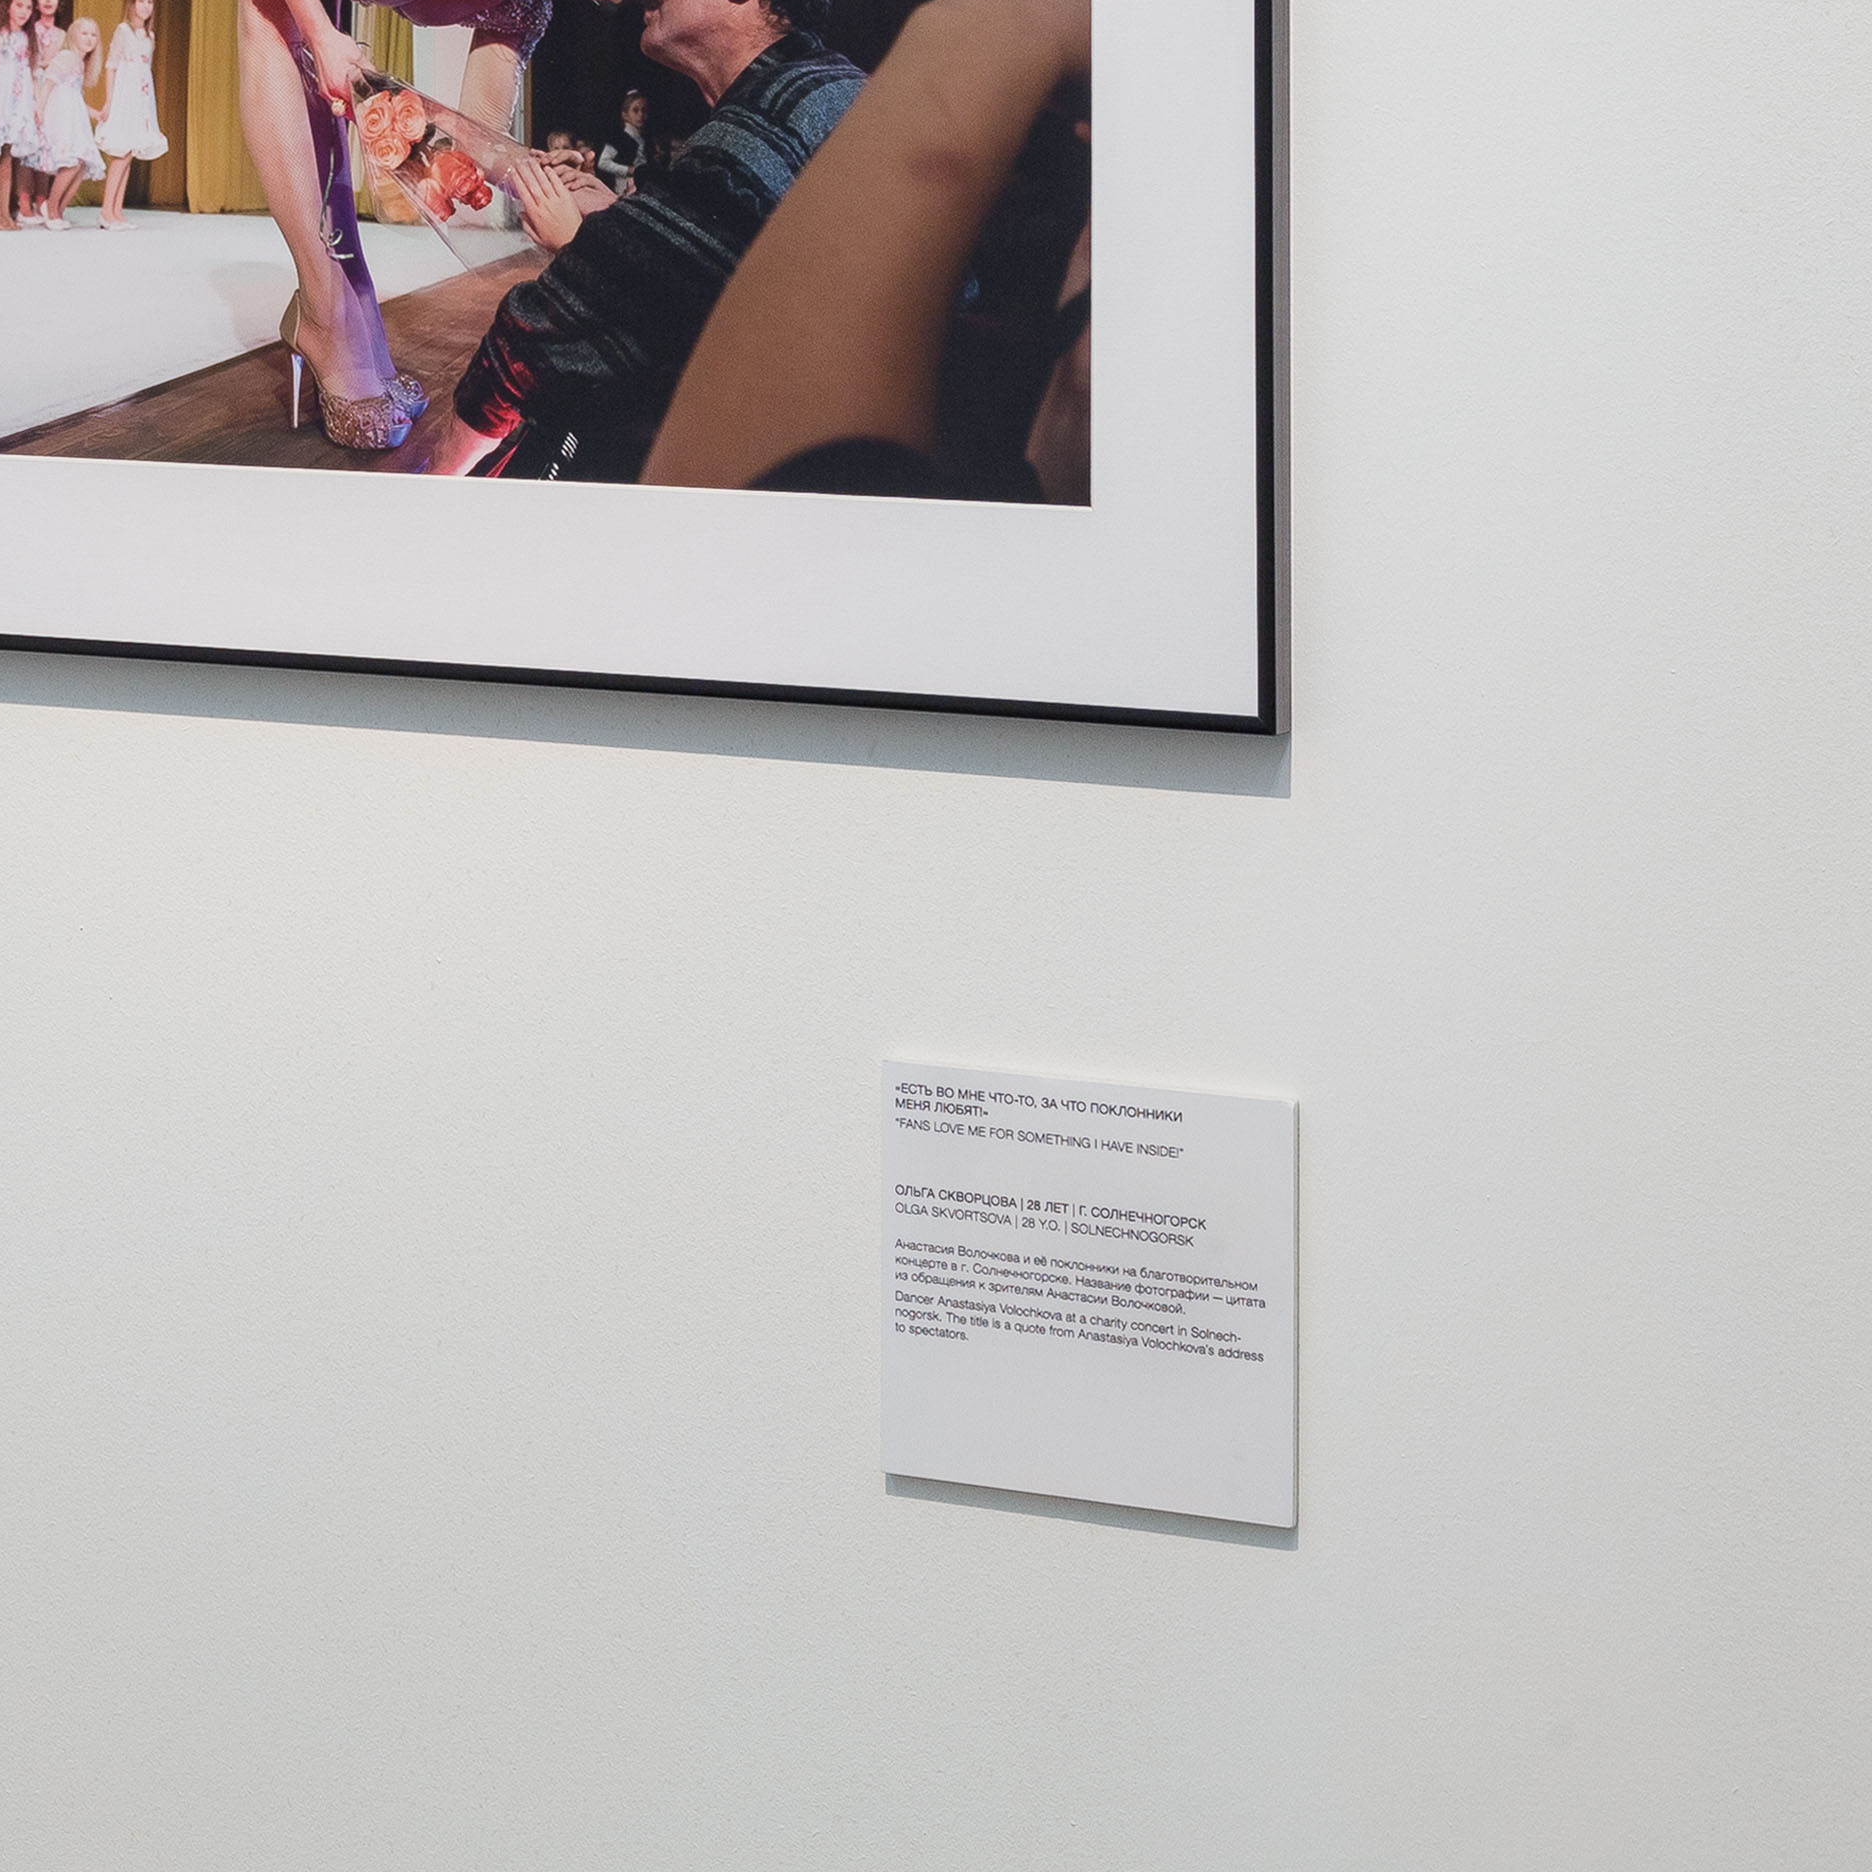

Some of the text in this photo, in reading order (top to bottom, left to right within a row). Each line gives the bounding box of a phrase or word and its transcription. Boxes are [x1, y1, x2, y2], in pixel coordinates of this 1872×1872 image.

[895, 1082, 1183, 1123] «ЕСТЬ ВО МНЕ ЧТО-ТО, ЗА ЧТО ПОКЛОННИКИ
[895, 1097, 989, 1117] МЕНЯ ЛЮБЯТ!»
[933, 1121, 965, 1135] LOVE
[967, 1124, 986, 1138] ME
[989, 1126, 1014, 1140] FOR
[1016, 1129, 1091, 1149] SOMETHING
[1094, 1138, 1098, 1149] I
[1100, 1139, 1133, 1154] HAVE
[894, 1183, 936, 1199] ОЛЬГА
[938, 1188, 1018, 1209] СКВОРЦОВА
[1026, 1199, 1041, 1211] 28
[1044, 1201, 1070, 1214] ЛЕТ
[1090, 1206, 1207, 1230] СОЛНЕЧНОГОРСК
[894, 1201, 929, 1216] OLGA
[930, 1205, 1012, 1226] SKVORTSOVA
[1021, 1216, 1036, 1229] 28
[1070, 1221, 1194, 1247] SOLNECHNOGORSK
[894, 1238, 955, 1255] Анастасия
[957, 1245, 1020, 1264] Волочкова
[1023, 1255, 1031, 1264] и
[1050, 1258, 1120, 1275] поклонники
[1122, 1267, 1137, 1277] на
[1139, 1266, 1258, 1291] благотворительном
[894, 1256, 948, 1270] концерте
[950, 1262, 958, 1271] в
[972, 1262, 1072, 1285] Солнечногорске.
[1075, 1274, 1132, 1293] Название
[1134, 1282, 1210, 1302] фотографии
[1225, 1295, 1266, 1309] цитата
[894, 1271, 1186, 1315] из обращения к зрителям Анастасии Волочковой.
[894, 1289, 1242, 1343] Dancer Anastasiya Volochkova at a charity concert in Solnech-
[894, 1321, 969, 1341] to spectators.
[894, 1307, 942, 1322] nogorsk.
[945, 1311, 967, 1325] The
[969, 1315, 989, 1328] title
[992, 1317, 1001, 1329] is
[1003, 1321, 1012, 1330] a
[1014, 1322, 1046, 1335] quote
[1048, 1324, 1075, 1338] from
[1077, 1328, 1139, 1348] Anastasiya
[1217, 1347, 1264, 1363] address
